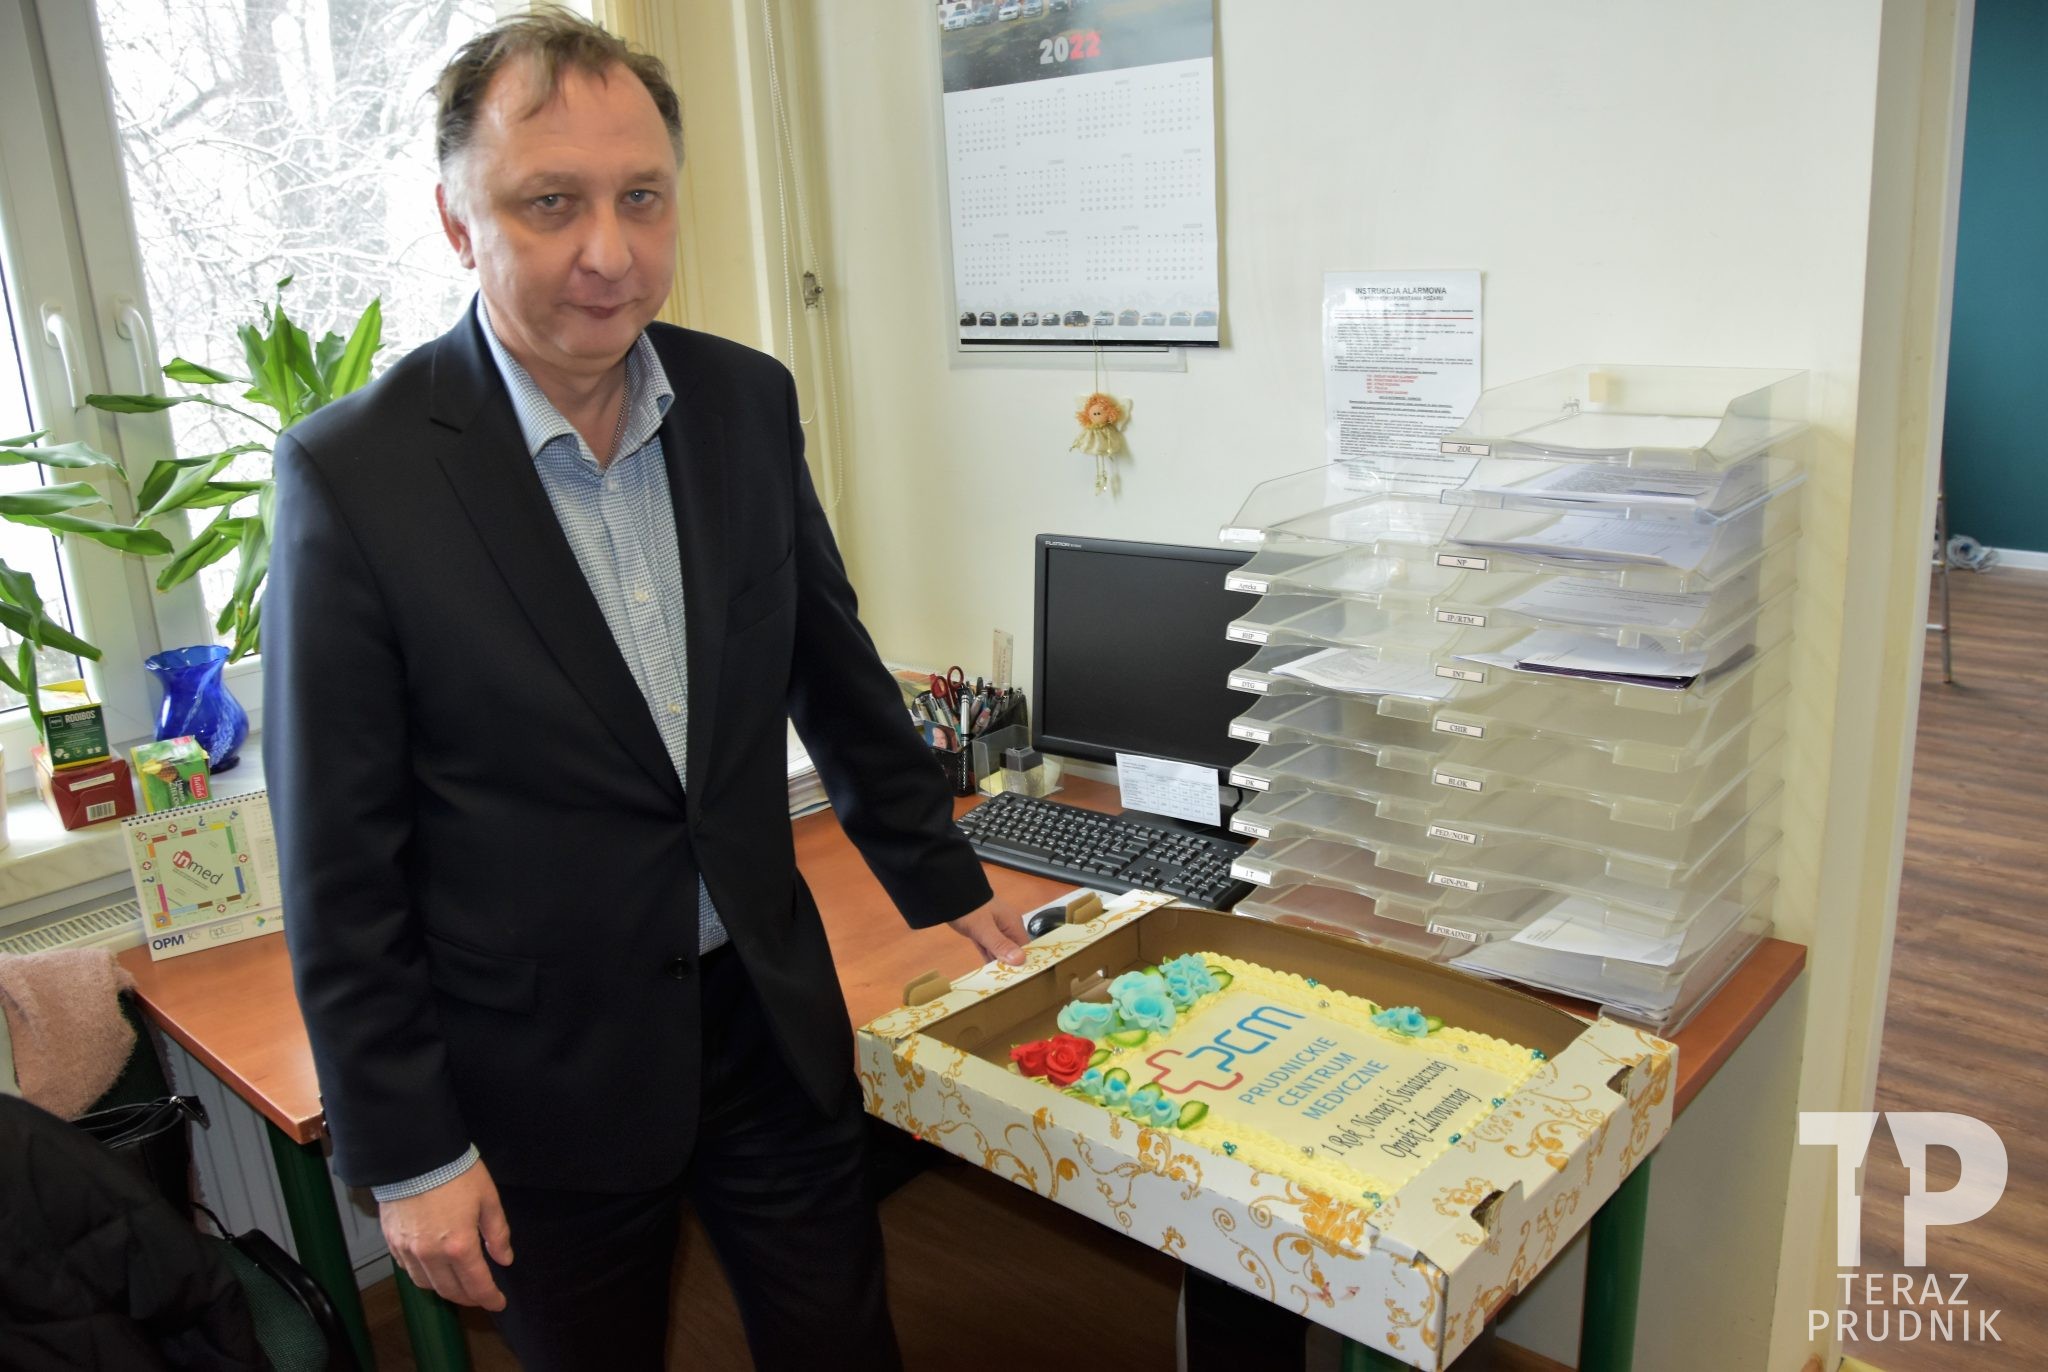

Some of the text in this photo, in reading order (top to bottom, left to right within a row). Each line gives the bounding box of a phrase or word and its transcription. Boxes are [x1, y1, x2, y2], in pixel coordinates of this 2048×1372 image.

[1039, 31, 1101, 65] 2022
[1355, 287, 1447, 295] INSTRUKCJA ALARMOWA
[1452, 670, 1465, 679] INT
[1450, 724, 1468, 733] CHIR
[1448, 777, 1467, 787] BLOK
[173, 850, 224, 885] inmed
[152, 934, 185, 950] OPM
[1436, 925, 1473, 940] PORADNIE
[1238, 1036, 1338, 1105] PRUDNICKIE
[1277, 1052, 1358, 1108] CENTRUM
[1302, 1059, 1389, 1120] MEDYCZNE
[1350, 1098, 1407, 1133] Nocnej
[1381, 1084, 1482, 1159] Opieki Zdrowotnej
[1328, 1124, 1376, 1149] Rok
